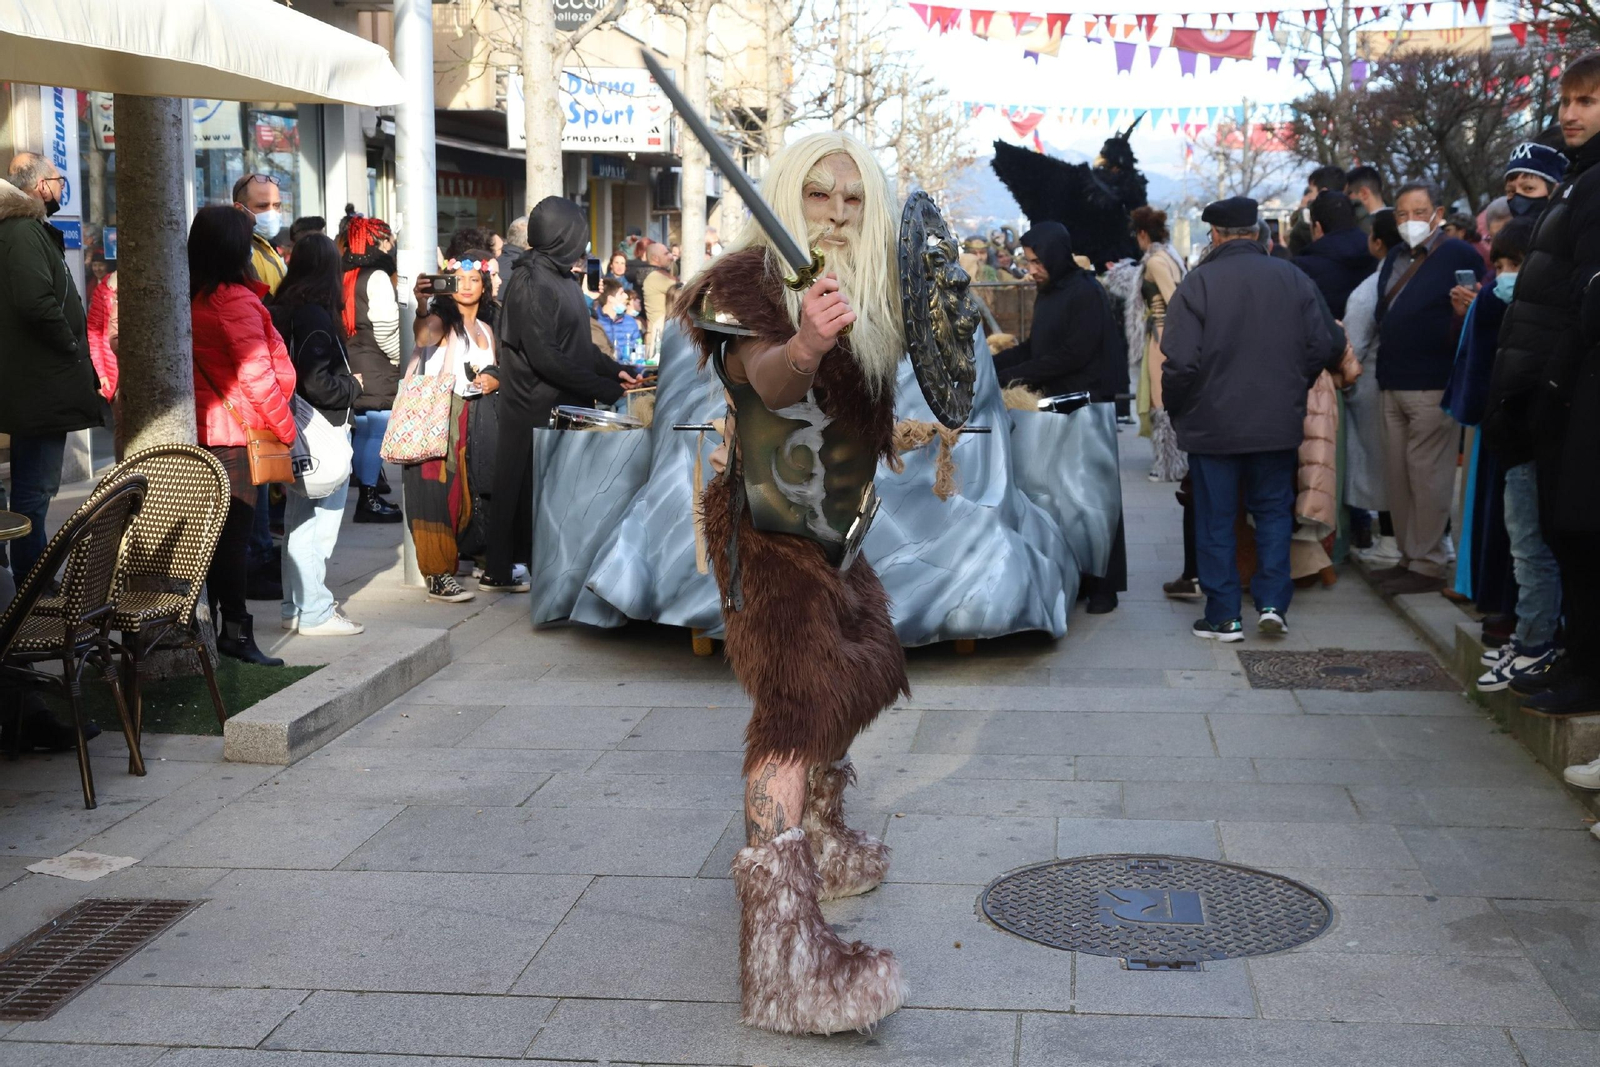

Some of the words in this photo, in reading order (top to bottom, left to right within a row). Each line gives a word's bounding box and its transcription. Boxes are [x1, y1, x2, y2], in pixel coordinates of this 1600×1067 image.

[552, 0, 609, 10] CCO
[567, 72, 635, 96] Dorna
[567, 101, 634, 129] Sport
[53, 87, 68, 171] ECUADO
[519, 134, 635, 144] wornasport.es
[292, 458, 313, 475] OEI
